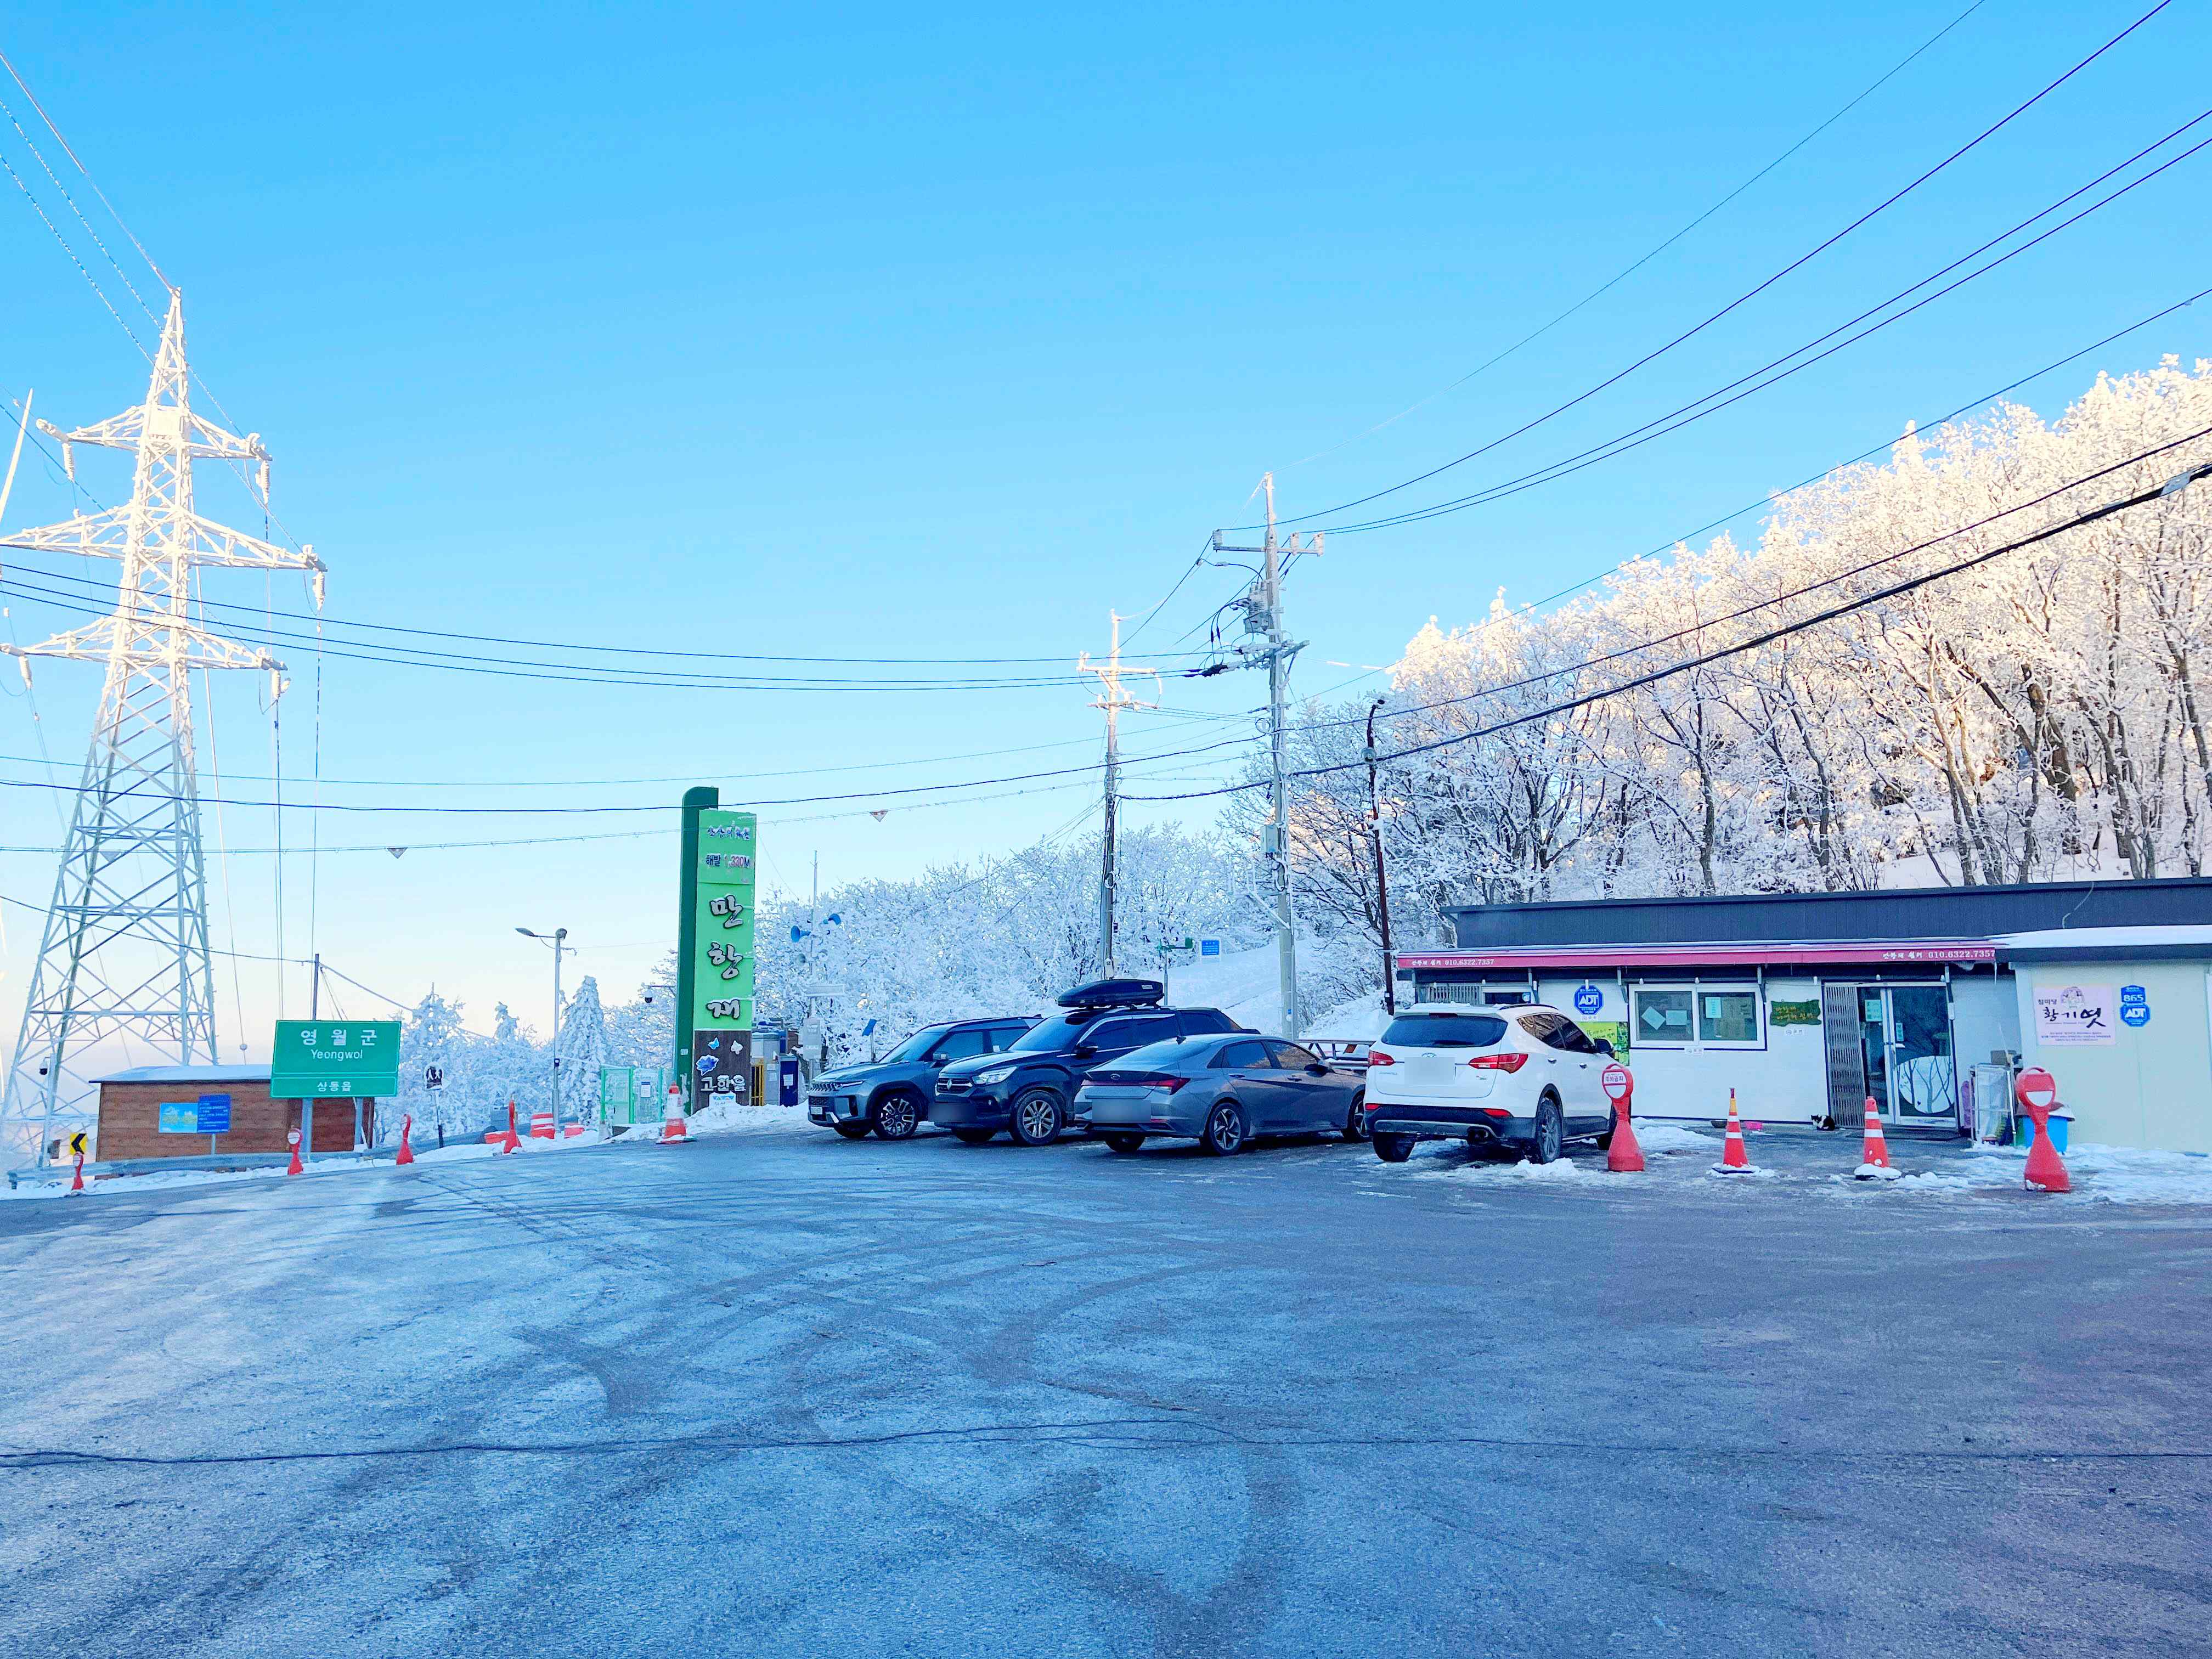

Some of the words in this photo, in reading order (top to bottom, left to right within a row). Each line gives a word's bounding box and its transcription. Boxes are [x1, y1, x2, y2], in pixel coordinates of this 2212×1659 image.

[706, 854, 721, 867] 해발
[1928, 949, 1996, 958] 010.6322.7357
[1579, 994, 1599, 1006] ADT
[2125, 1008, 2146, 1019] ADT
[301, 1029, 377, 1046] 영월군
[311, 1049, 363, 1062] Yeongwol
[317, 1081, 352, 1092] 상동읍
